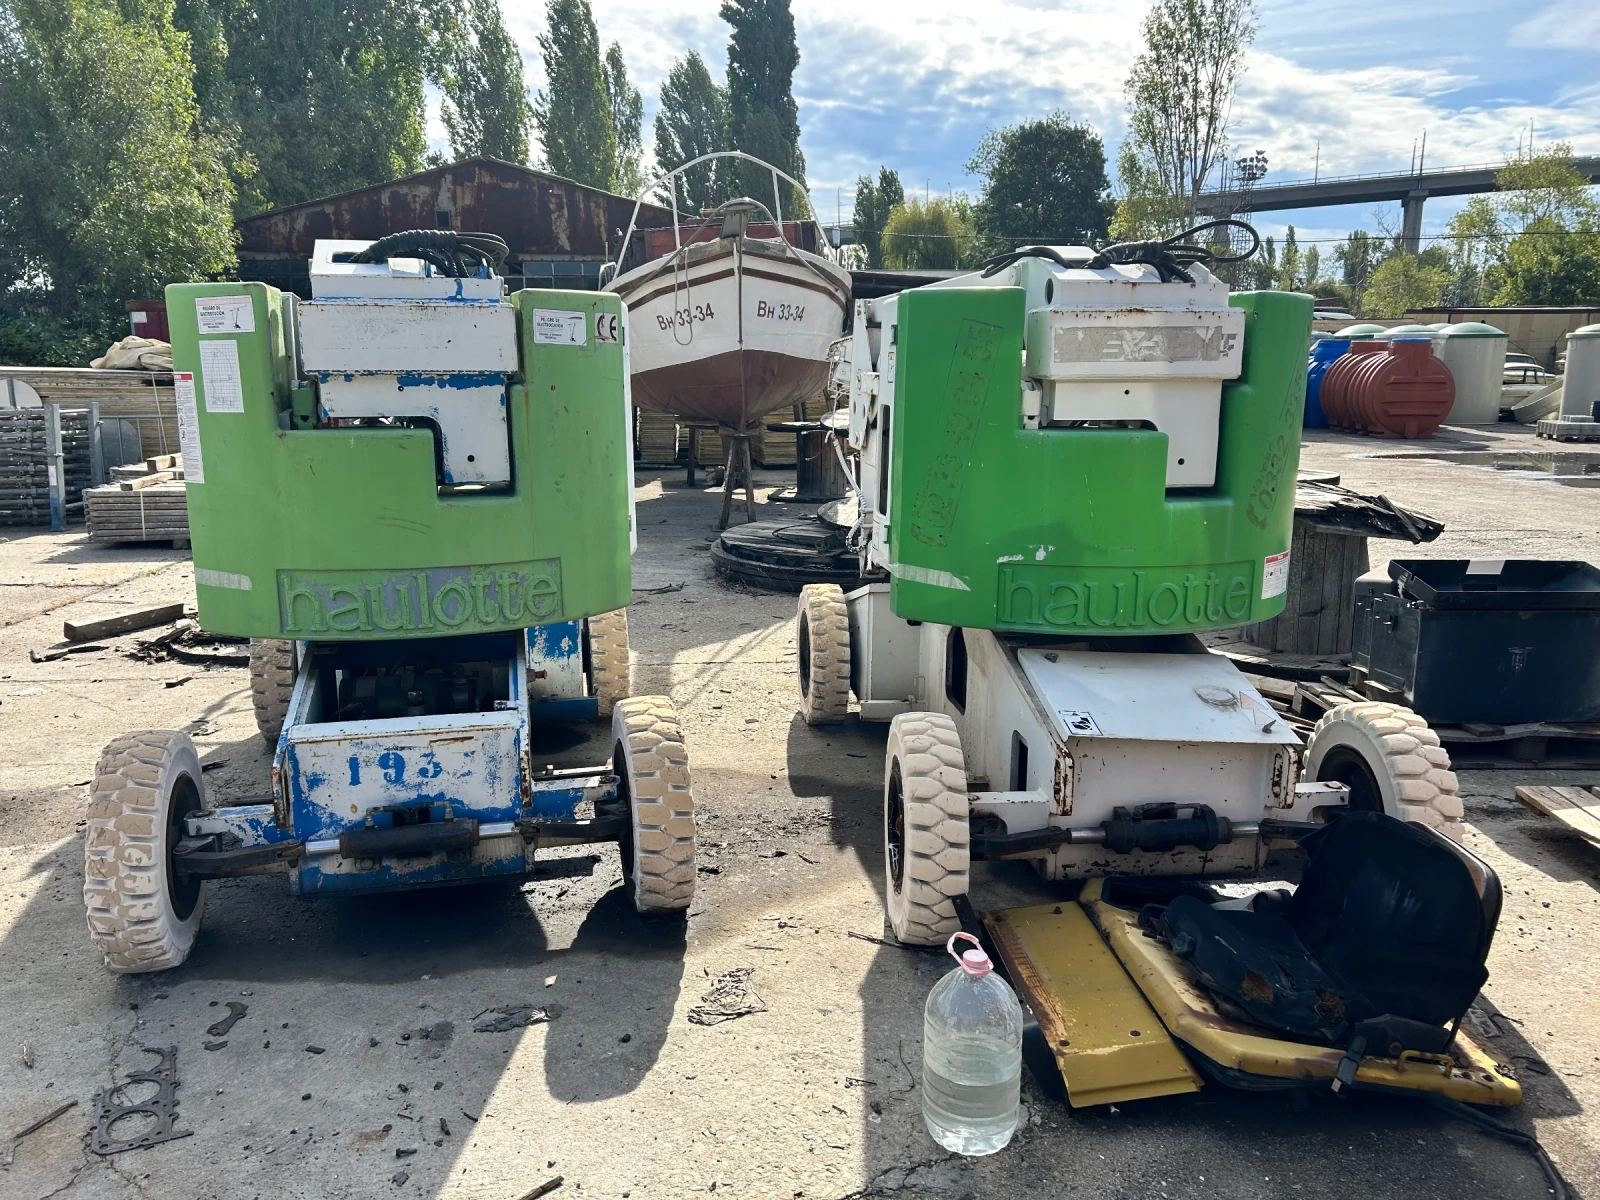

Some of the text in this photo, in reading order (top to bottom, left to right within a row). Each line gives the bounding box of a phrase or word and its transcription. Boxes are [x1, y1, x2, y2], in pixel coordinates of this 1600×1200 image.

[675, 302, 715, 327] 33-34
[778, 303, 806, 322] 33-34
[281, 571, 558, 632] haulotte
[1000, 567, 1250, 627] haulotte
[348, 750, 443, 787] 193
